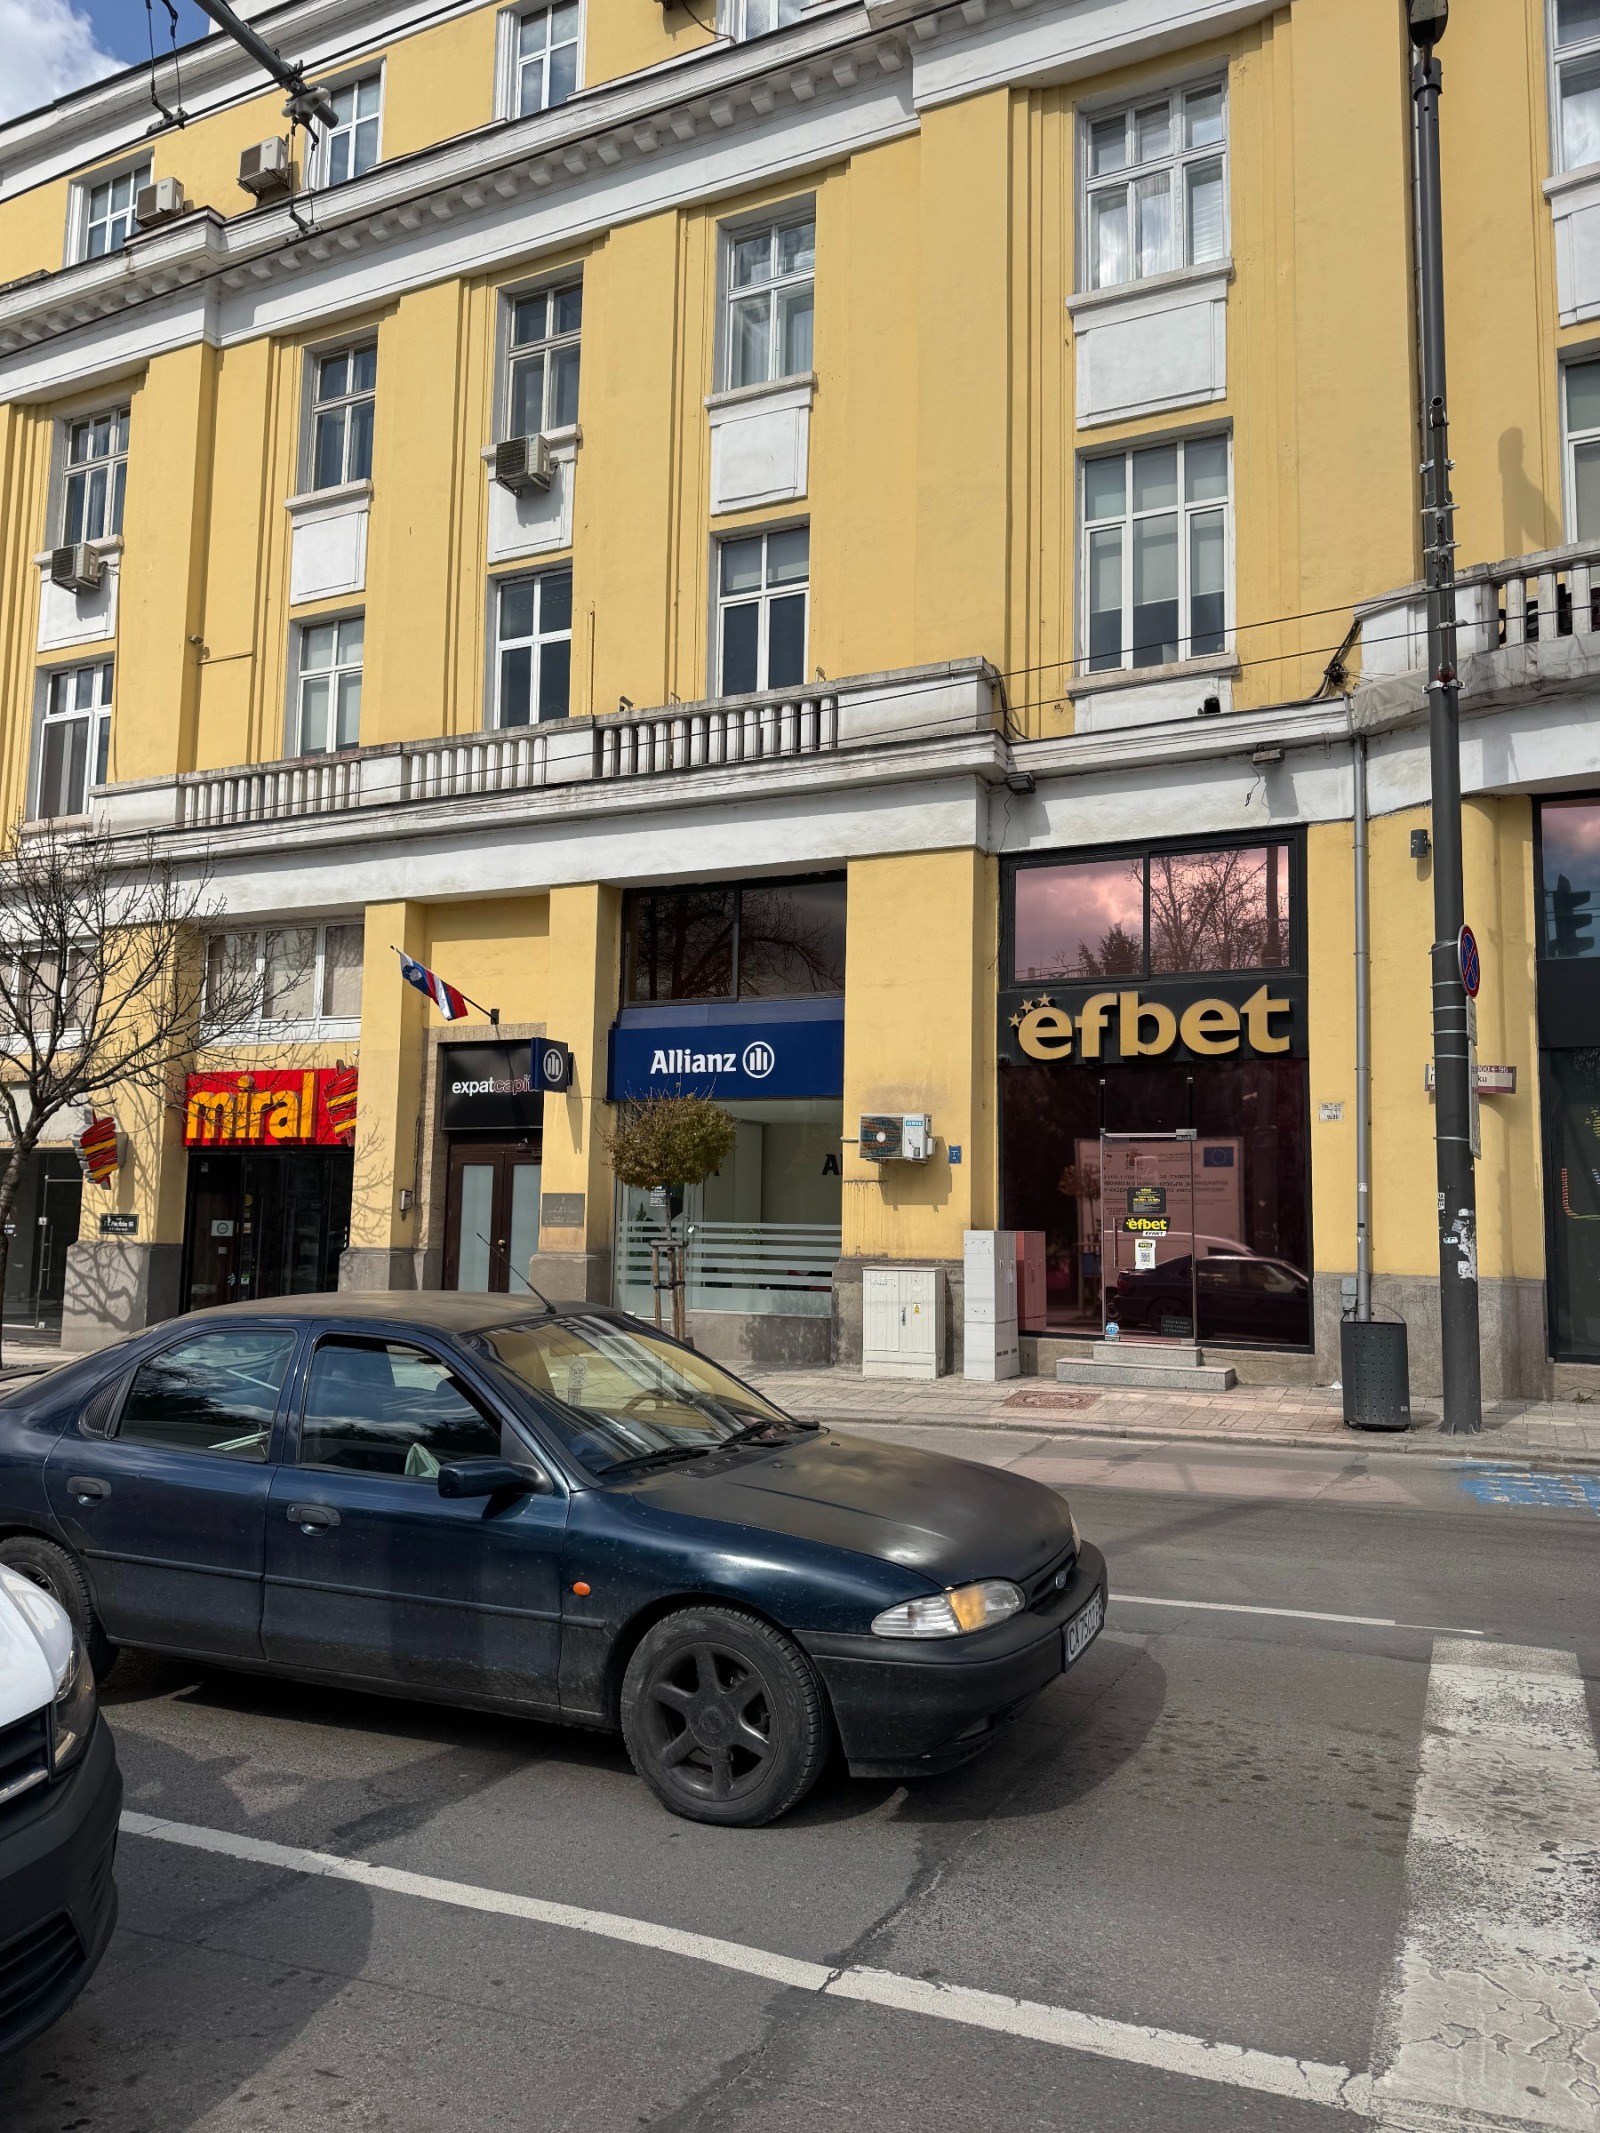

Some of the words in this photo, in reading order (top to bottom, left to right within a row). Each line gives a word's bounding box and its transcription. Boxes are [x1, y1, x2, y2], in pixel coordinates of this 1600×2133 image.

[1018, 985, 1290, 1060] efbet
[650, 1048, 737, 1075] Allianz
[186, 1072, 316, 1139] miral
[1128, 1218, 1167, 1230] efbet
